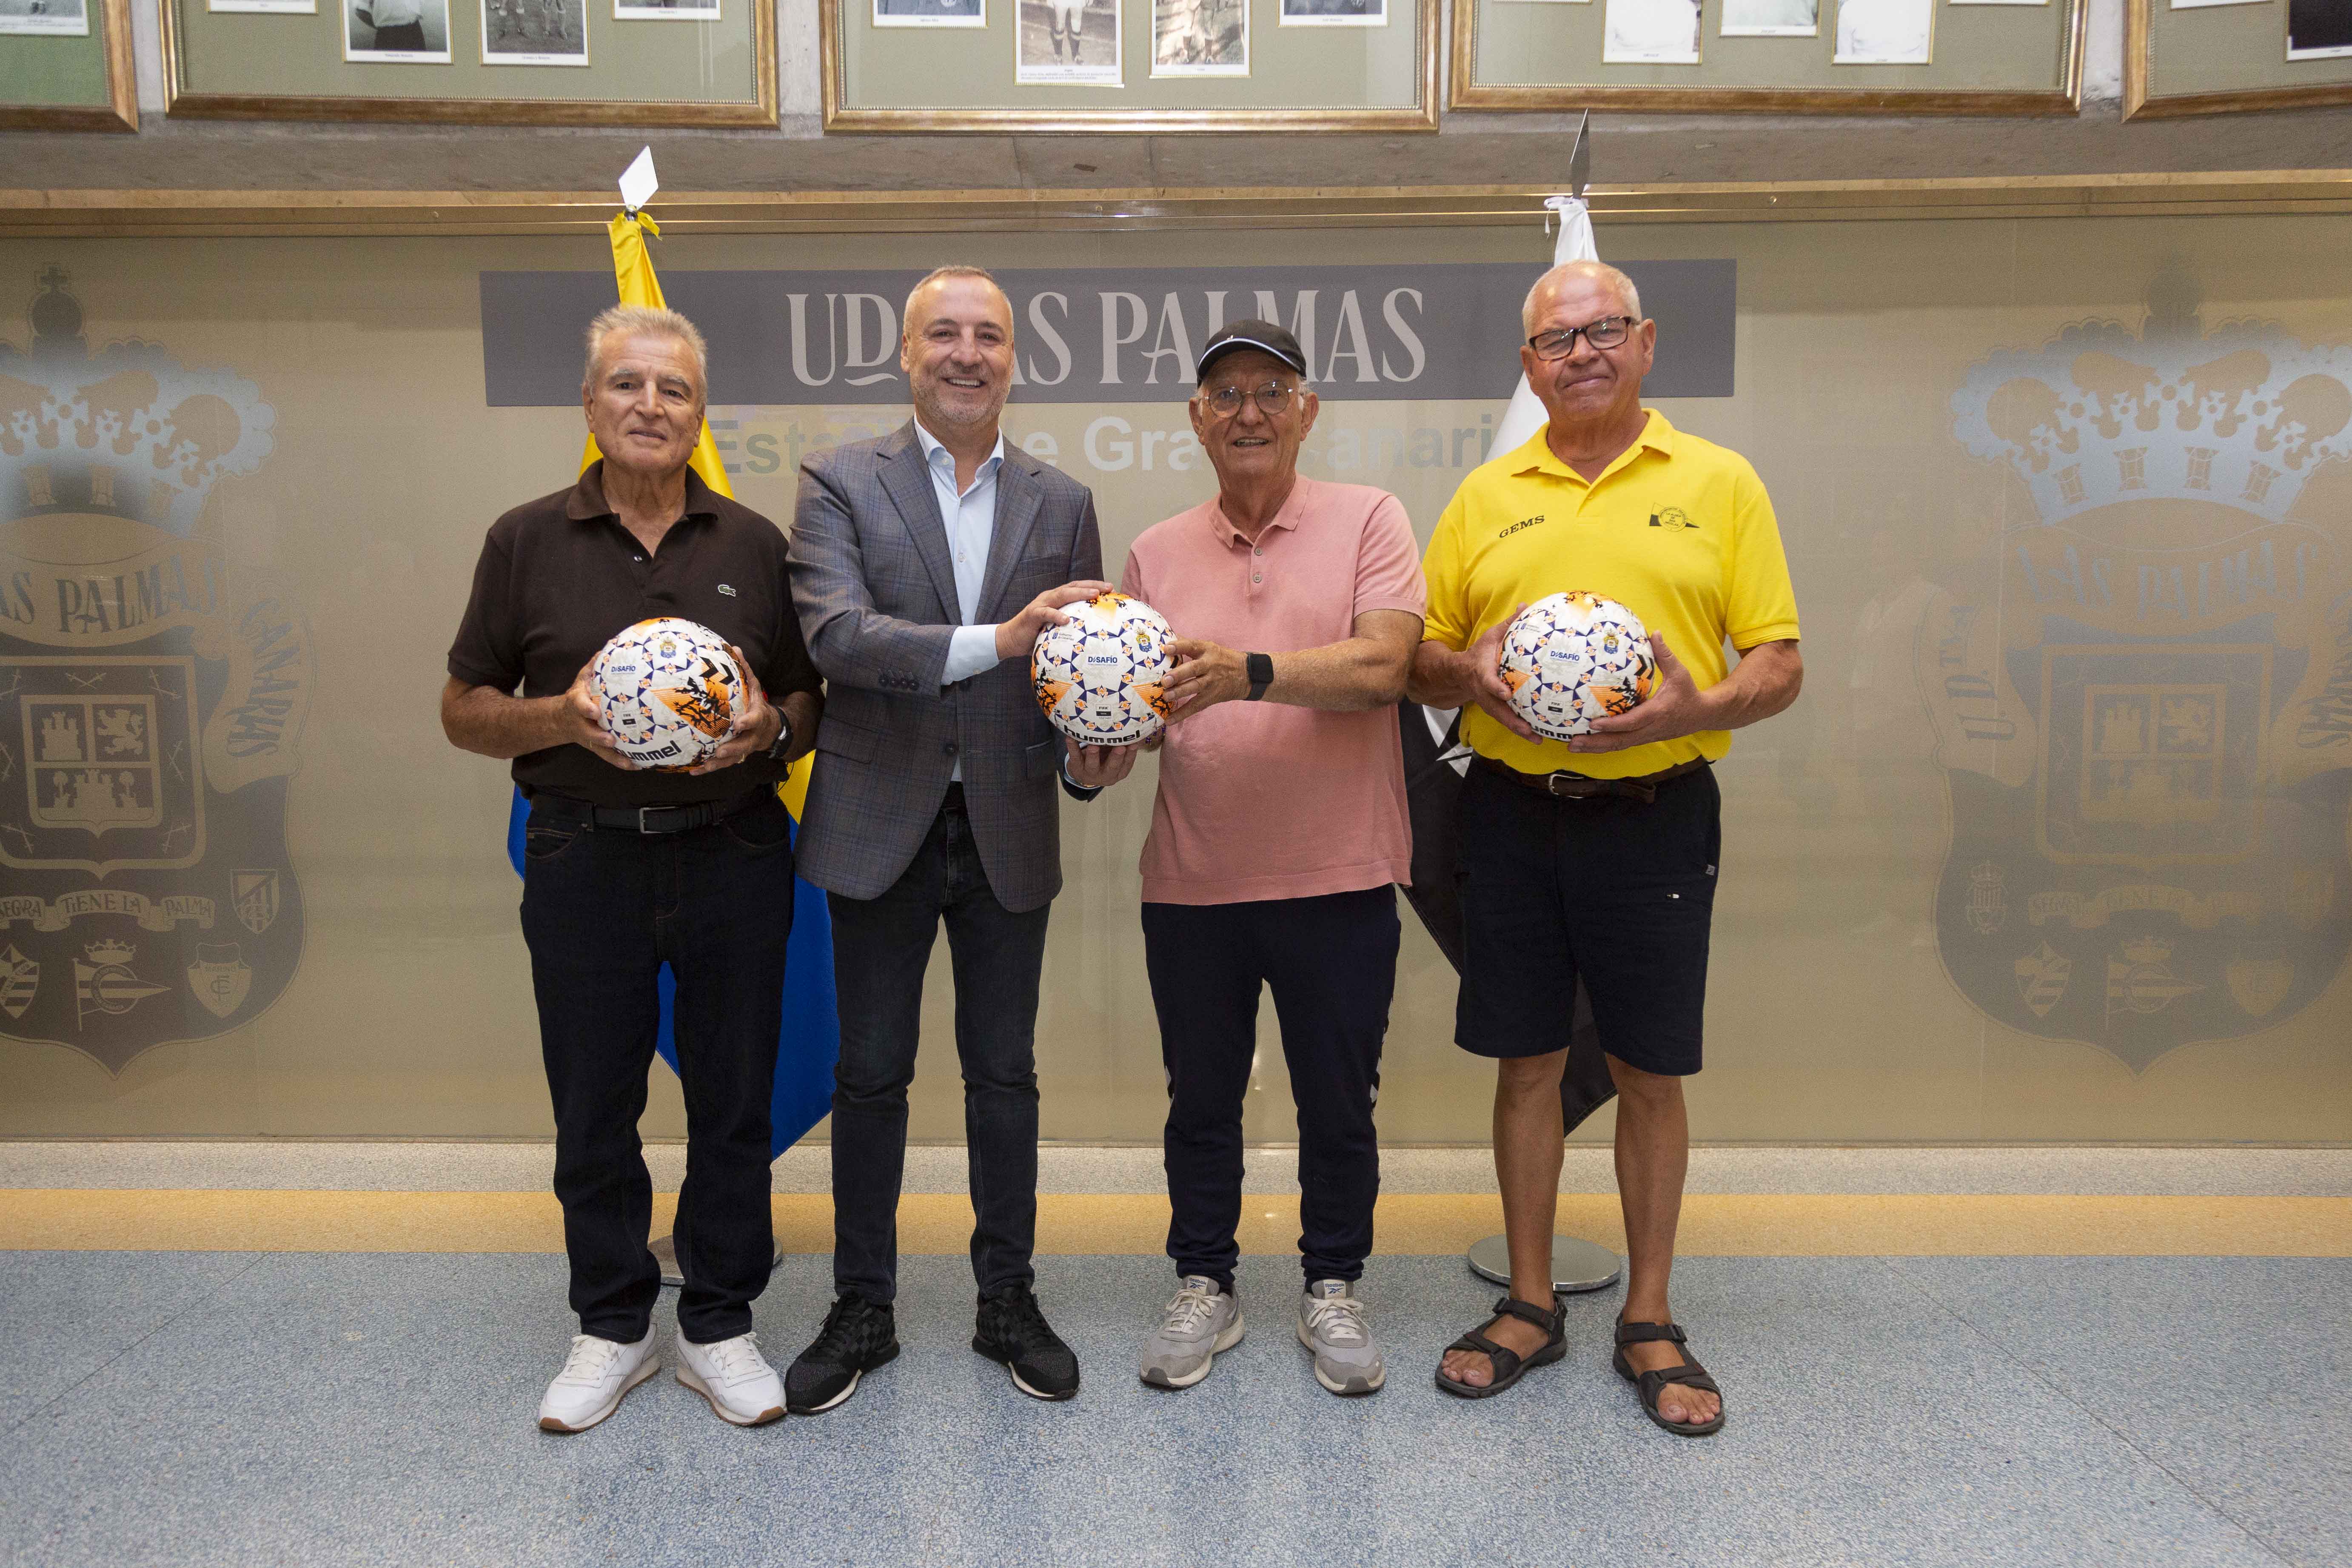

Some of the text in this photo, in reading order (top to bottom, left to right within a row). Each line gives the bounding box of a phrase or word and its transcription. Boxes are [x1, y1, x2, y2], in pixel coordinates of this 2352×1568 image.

[787, 294, 898, 386] UD
[1084, 416, 1203, 471] Gra
[1304, 414, 1492, 470] anari
[1500, 515, 1545, 538] GEMS
[1064, 724, 1140, 743] hummel
[1189, 1277, 1207, 1286] Reebok
